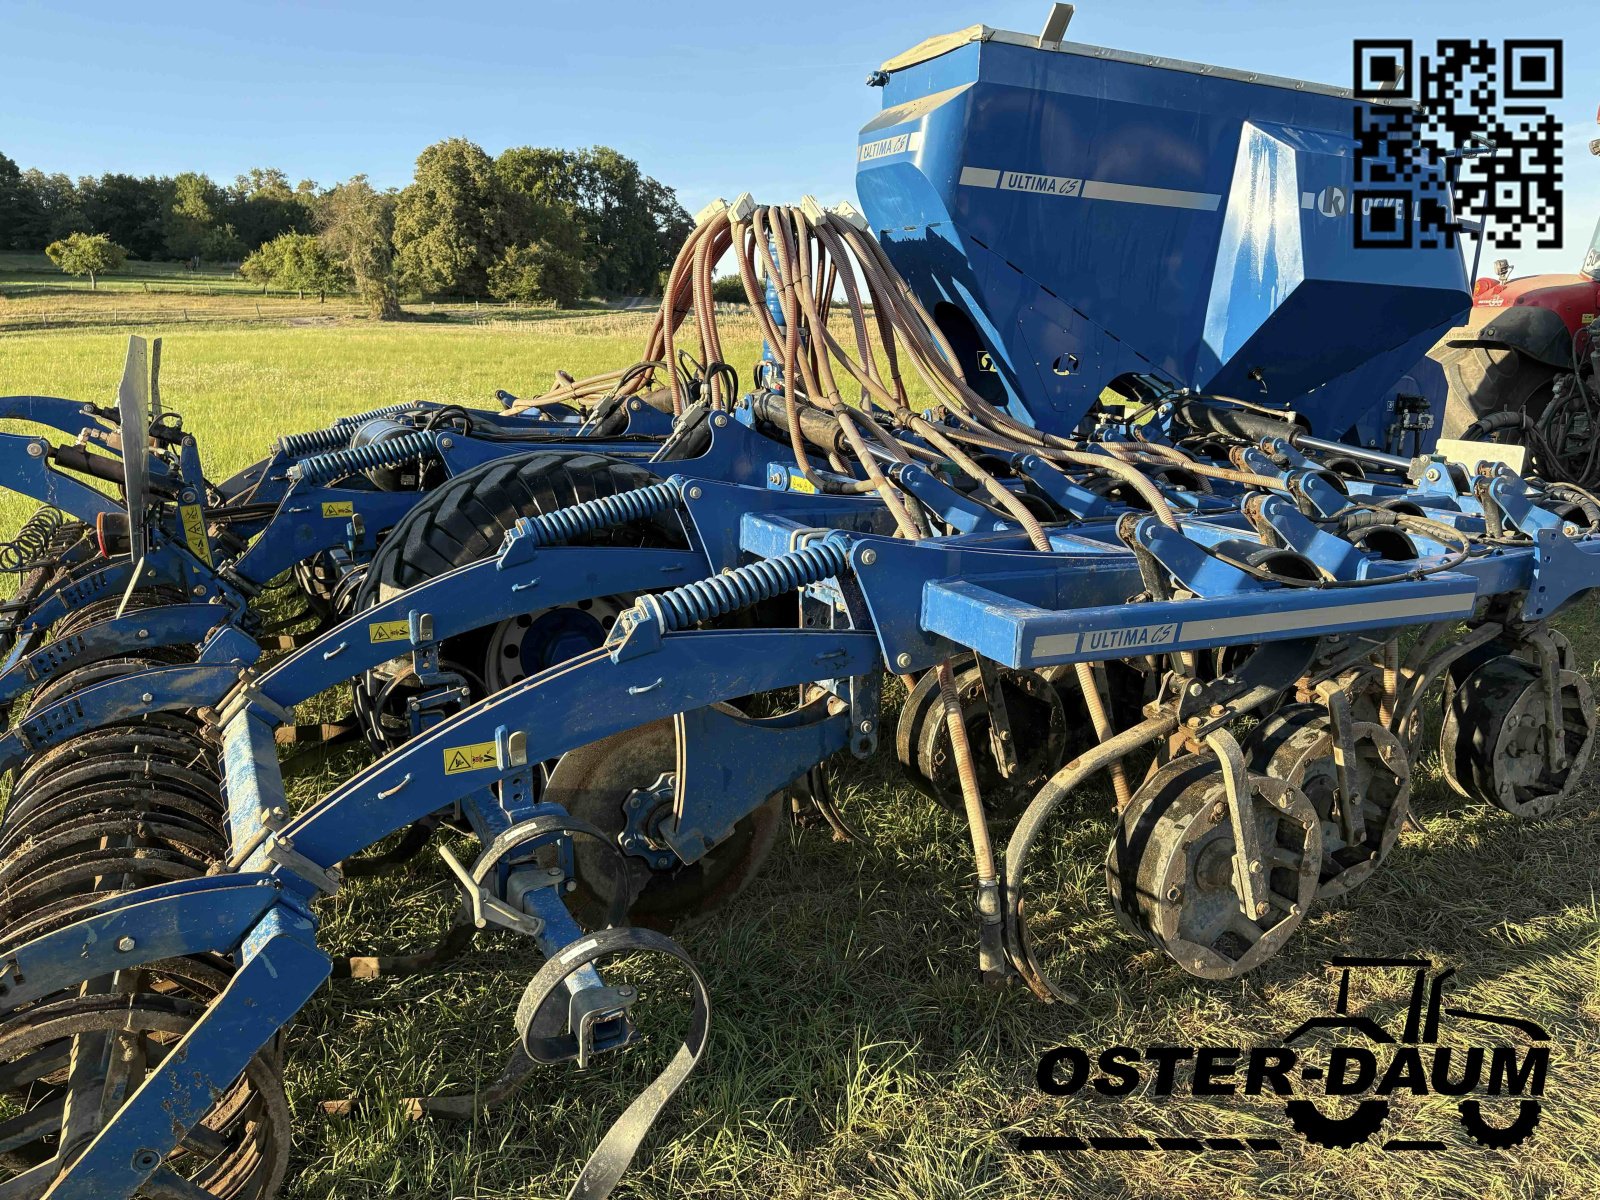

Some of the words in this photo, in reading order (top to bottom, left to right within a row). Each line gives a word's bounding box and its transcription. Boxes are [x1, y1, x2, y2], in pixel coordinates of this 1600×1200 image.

[863, 139, 892, 159] ULTIMA
[1008, 173, 1056, 192] ULTIMA
[1059, 180, 1079, 194] CS
[1090, 628, 1148, 650] ULTIMA
[1151, 625, 1174, 643] CS
